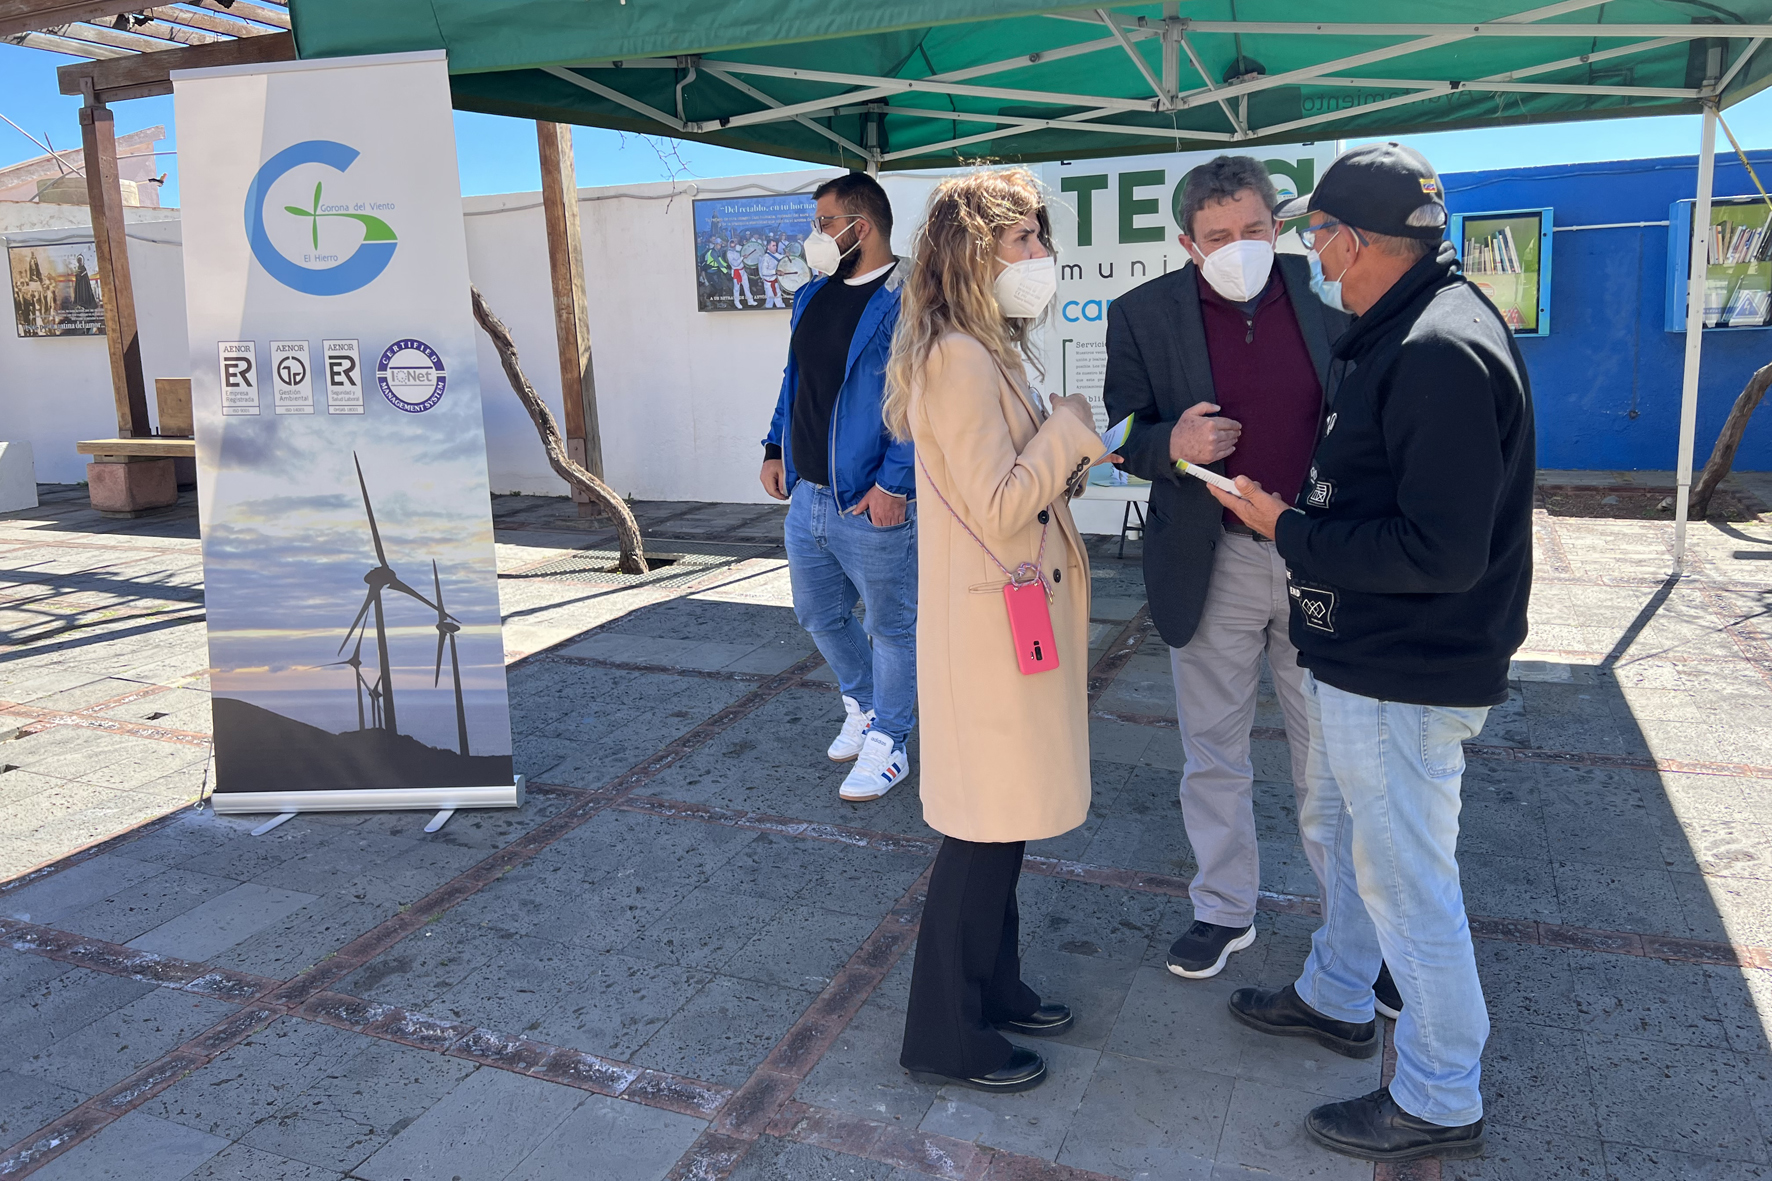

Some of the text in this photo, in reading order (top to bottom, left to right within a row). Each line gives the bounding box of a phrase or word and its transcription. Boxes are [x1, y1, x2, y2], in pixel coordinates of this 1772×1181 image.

[320, 202, 396, 212] Gorona del Viento
[304, 254, 338, 262] El Hierro
[382, 341, 438, 365] CERTIFIED
[391, 370, 432, 385] IQNet
[380, 381, 445, 412] MANAGEMENT SYSTEM
[870, 736, 887, 746] adidas
